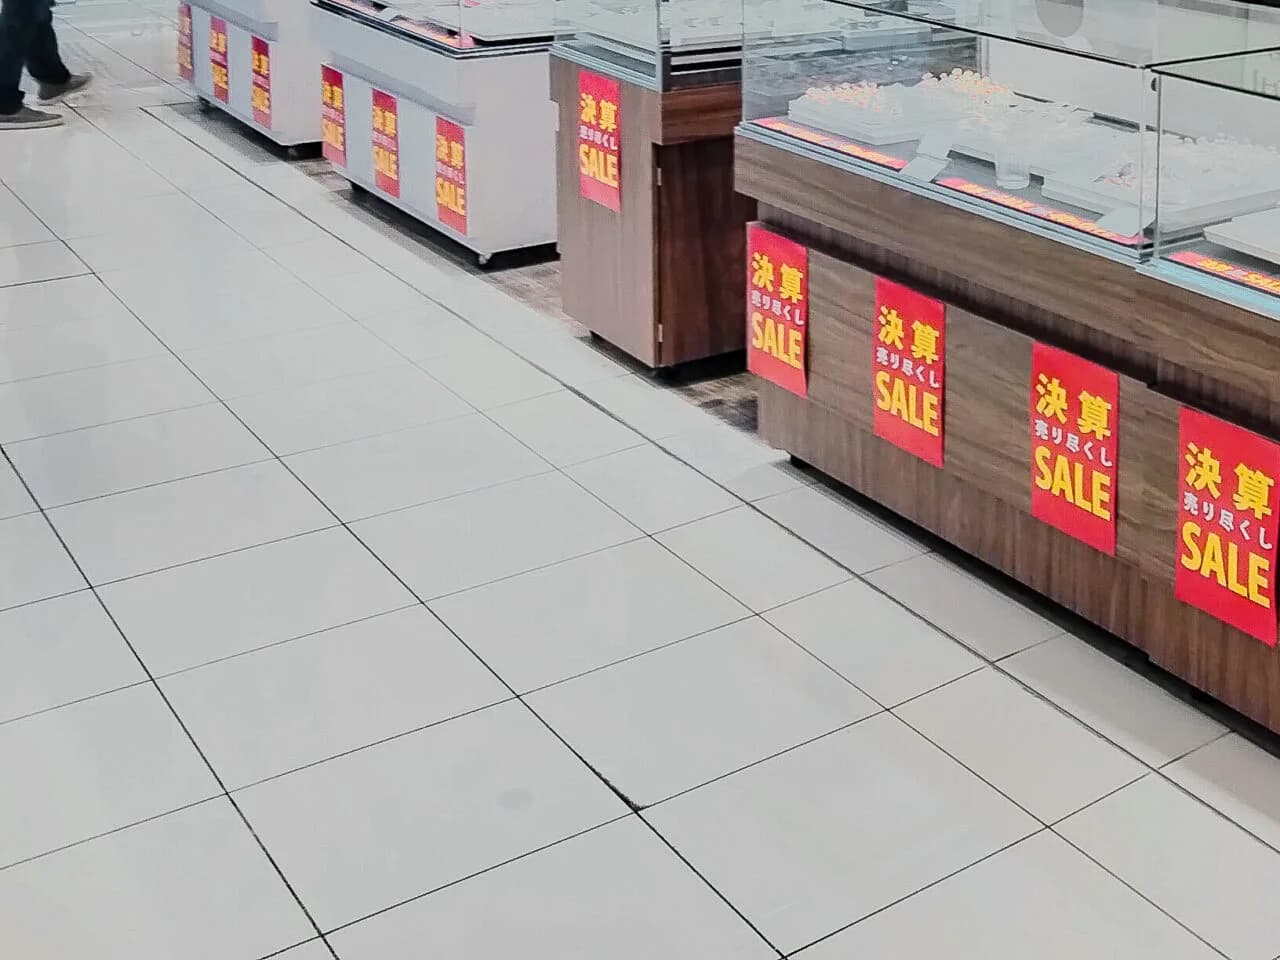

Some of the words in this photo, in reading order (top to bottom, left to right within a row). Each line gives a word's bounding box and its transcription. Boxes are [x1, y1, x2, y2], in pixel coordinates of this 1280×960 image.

[579, 143, 619, 189] SALE
[751, 251, 803, 304] 決算
[751, 311, 803, 370] SALE
[877, 305, 939, 364] 決算
[875, 346, 940, 389] 売り尽くし
[874, 370, 939, 437] SALE
[1034, 373, 1112, 441] 決算
[1034, 418, 1113, 468] 売り尽くし
[1034, 445, 1111, 522] SALE
[1184, 441, 1275, 520] 決算
[1183, 491, 1273, 551] 売り尽くし
[1180, 521, 1271, 609] SALE
